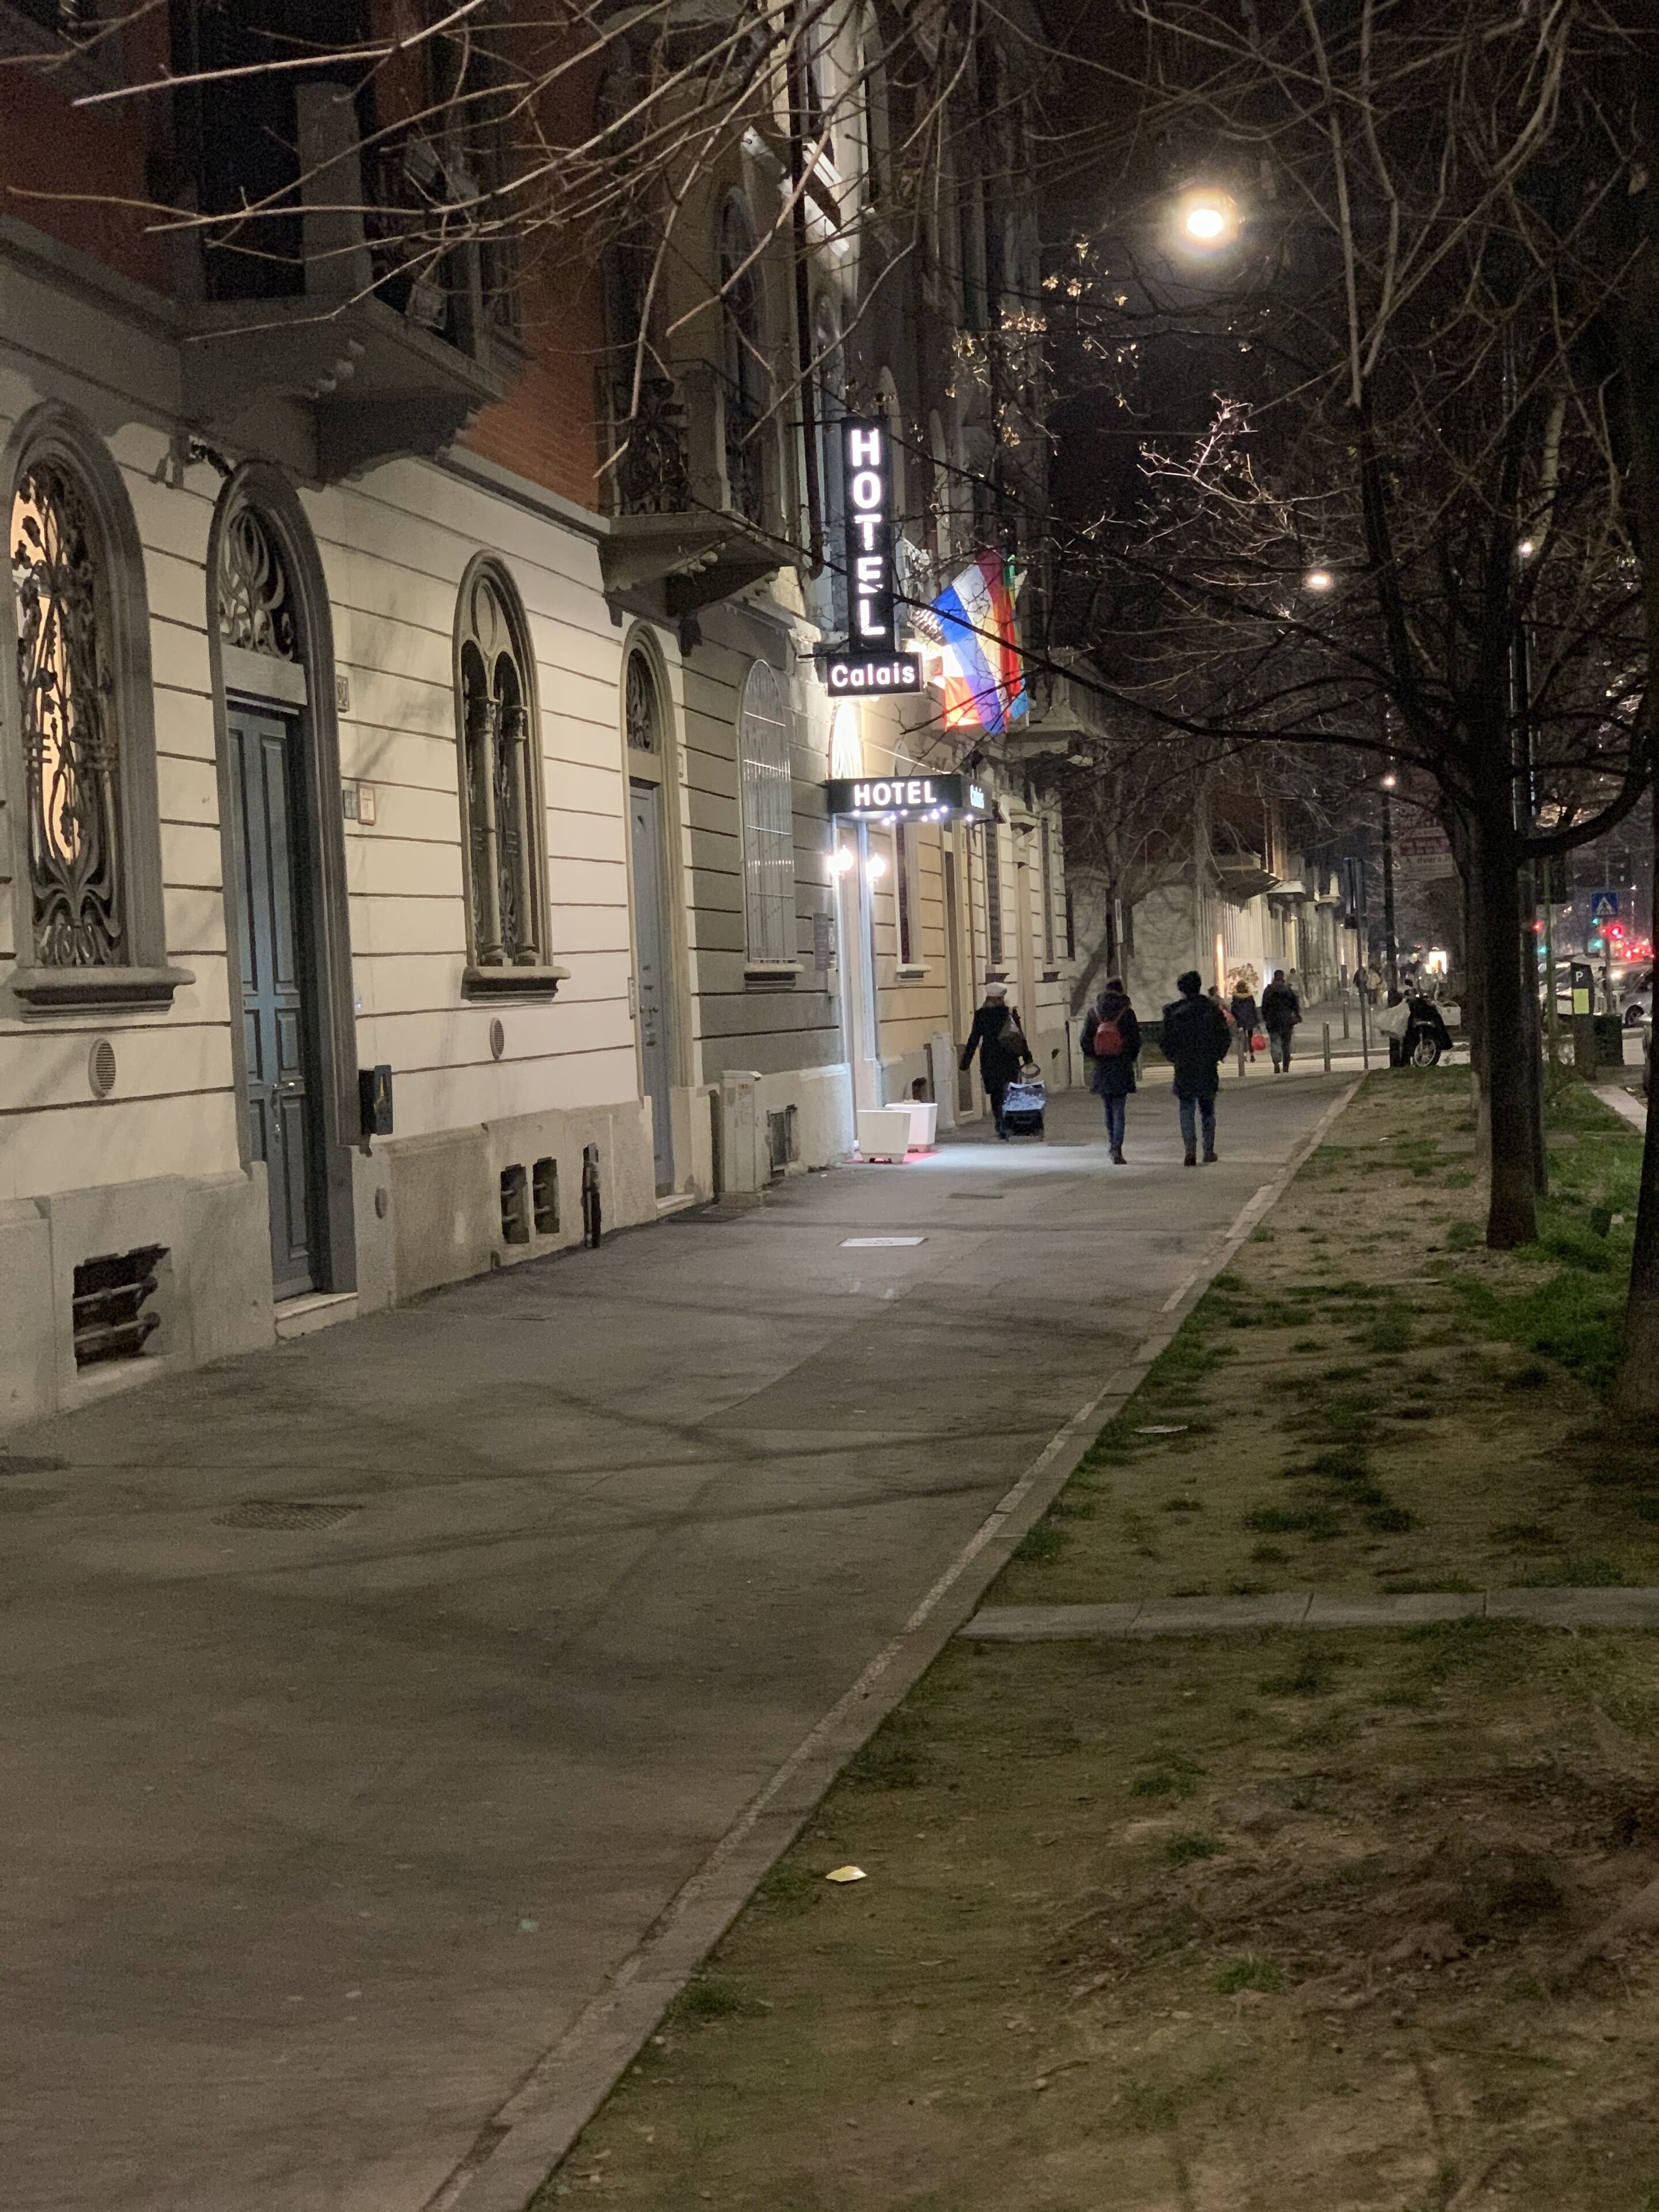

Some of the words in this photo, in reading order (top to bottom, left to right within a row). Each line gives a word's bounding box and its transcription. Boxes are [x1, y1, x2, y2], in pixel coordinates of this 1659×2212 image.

[850, 427, 885, 636] HOTEL
[831, 662, 915, 687] Calais
[854, 781, 937, 806] HOTEL
[1575, 971, 1584, 982] P
